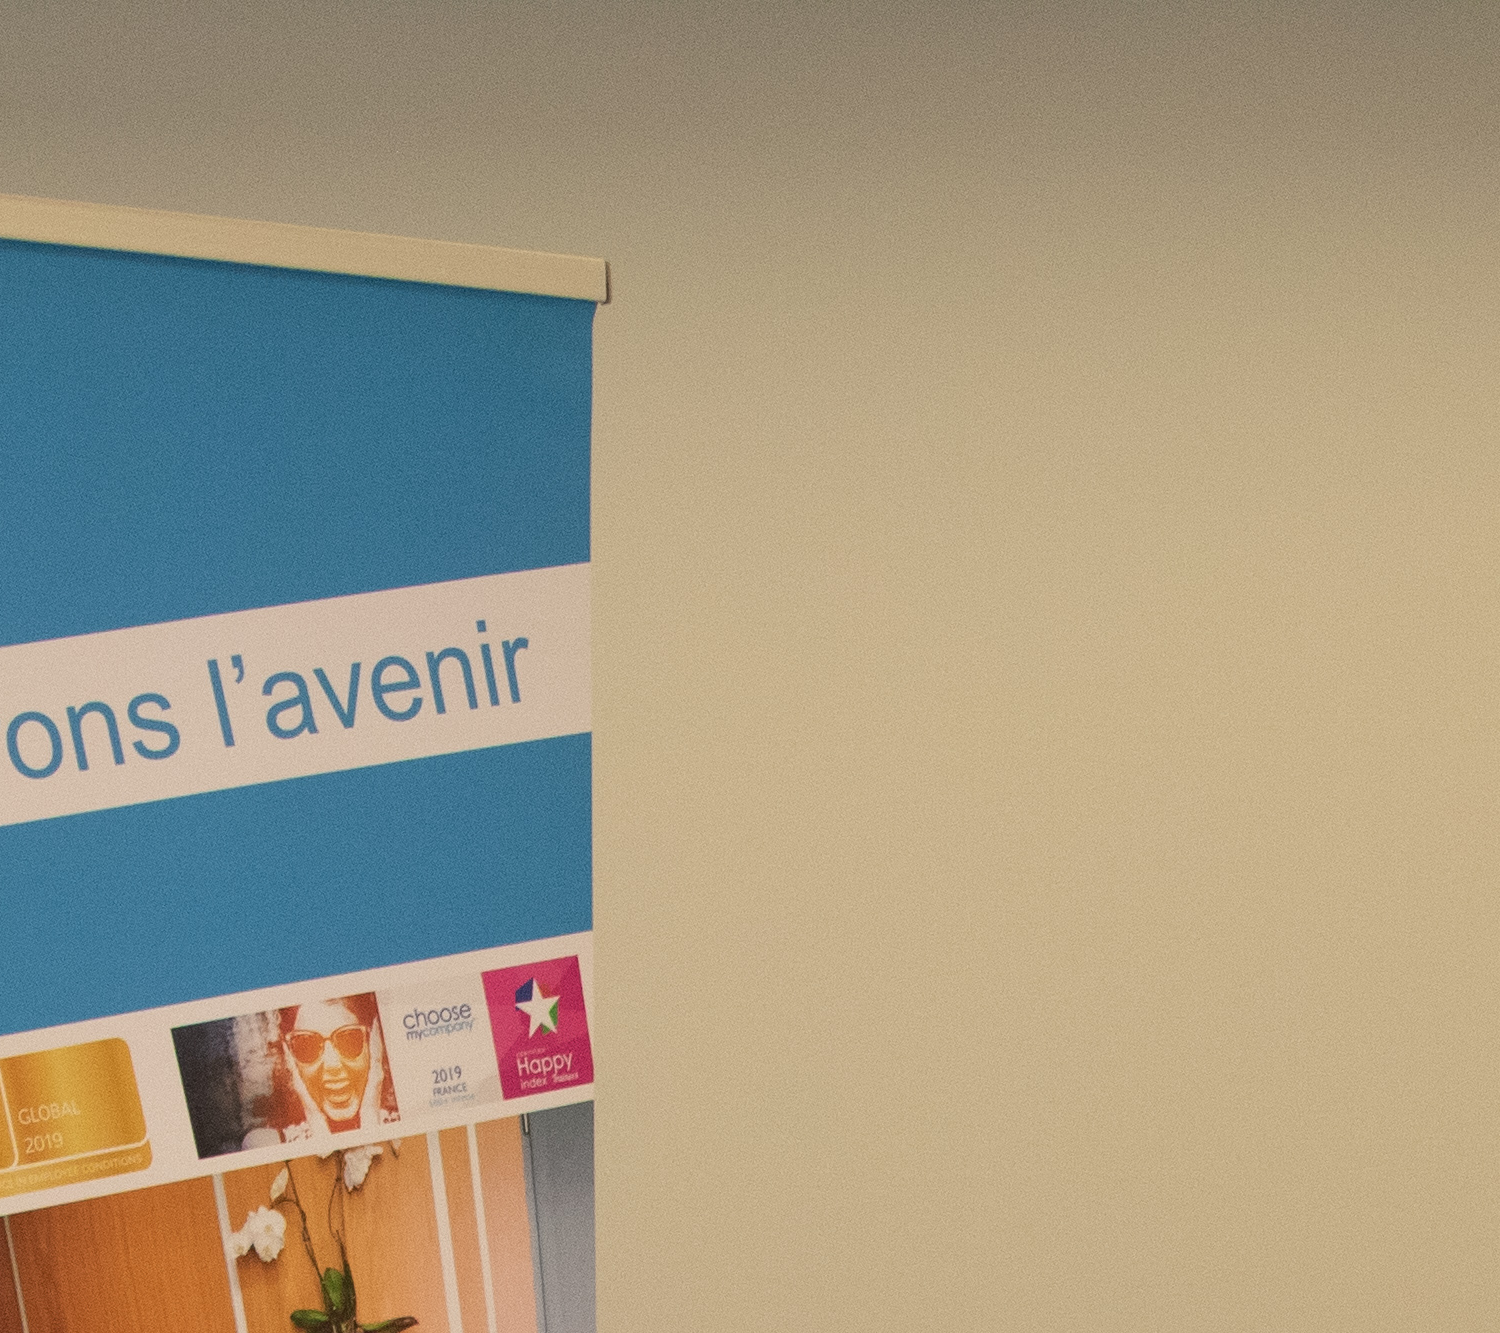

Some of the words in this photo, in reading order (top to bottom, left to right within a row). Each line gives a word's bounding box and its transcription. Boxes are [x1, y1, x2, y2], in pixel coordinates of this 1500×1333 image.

[400, 1003, 472, 1030] choose
[432, 1066, 463, 1085] 2019
[517, 1053, 574, 1077] Happy
[433, 1083, 467, 1097] FRANCE
[17, 1101, 81, 1126] GLOBAL
[24, 1132, 65, 1155] 2019
